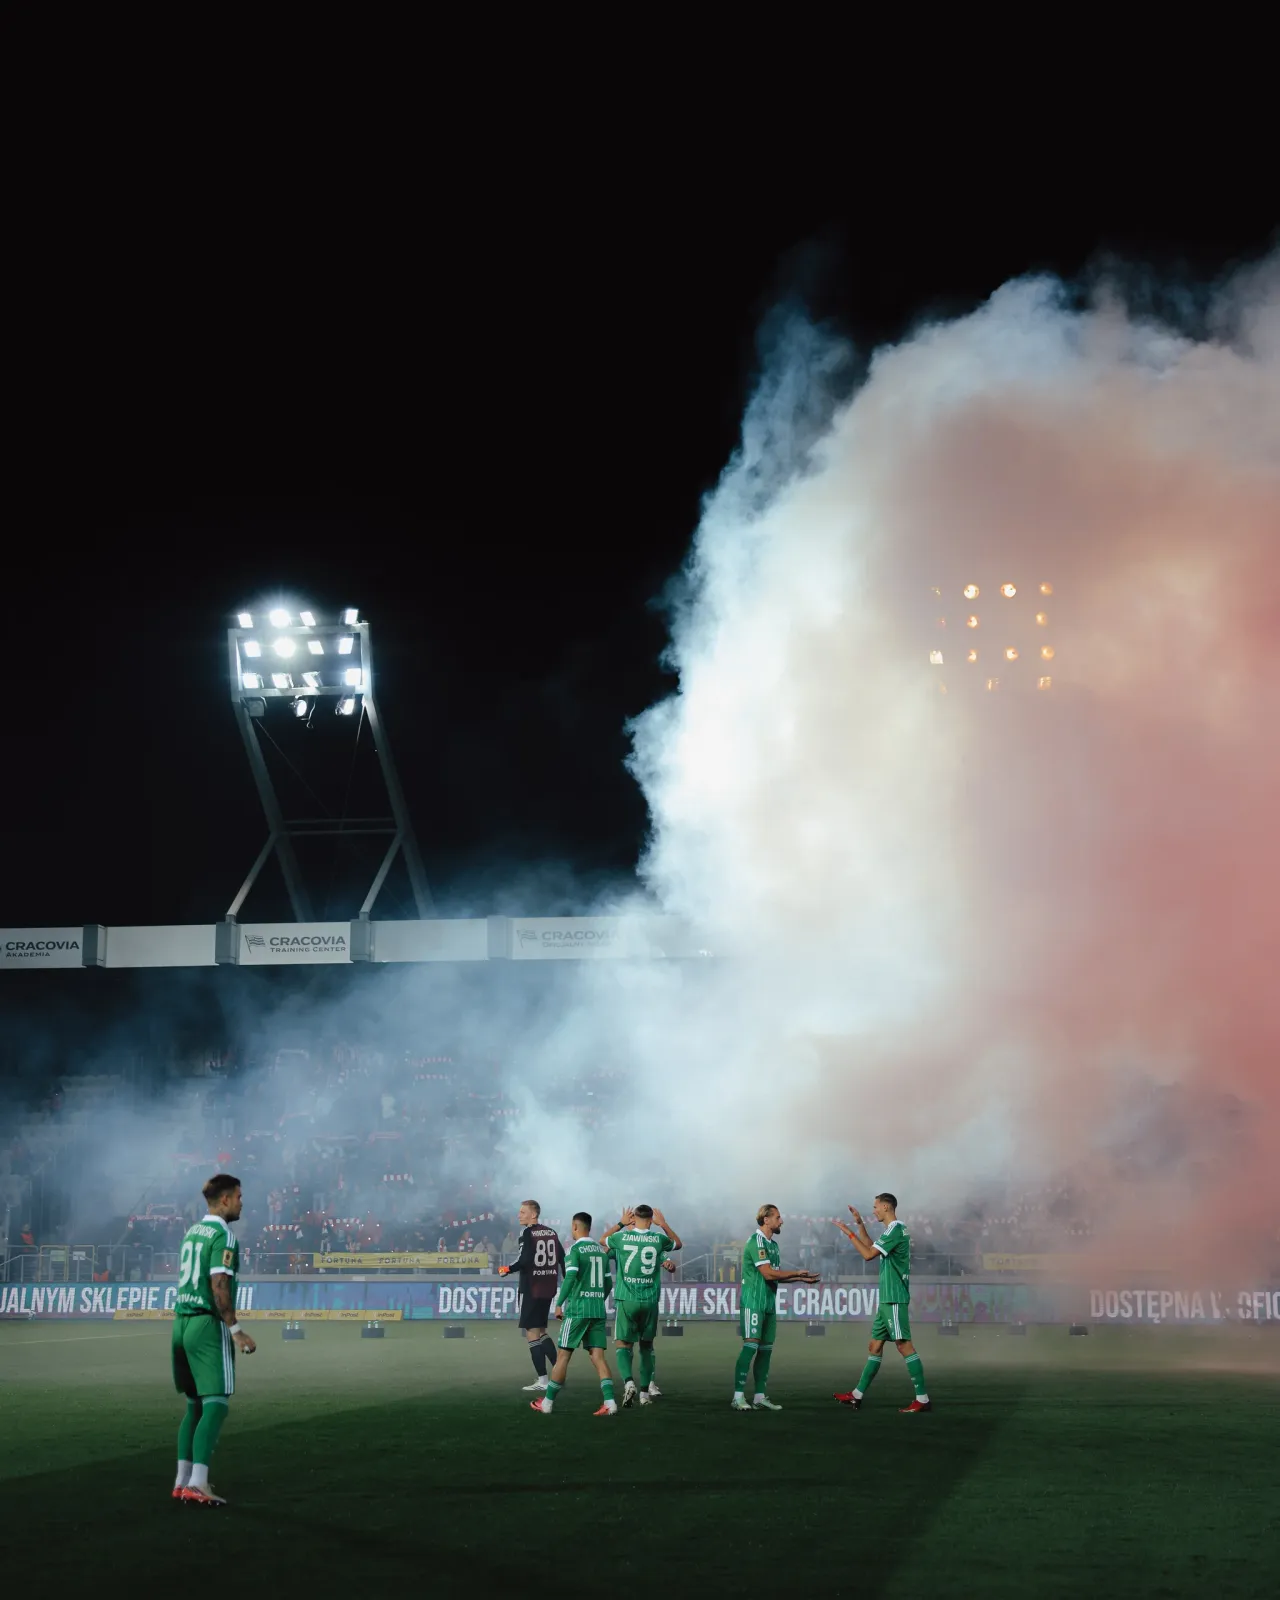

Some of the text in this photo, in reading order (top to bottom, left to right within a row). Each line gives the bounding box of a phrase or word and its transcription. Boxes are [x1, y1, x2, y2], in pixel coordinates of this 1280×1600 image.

[5, 941, 80, 951] CRACOVIA
[269, 935, 346, 946] CRACOVIA
[622, 1233, 660, 1243] ZJAWIŃSKI
[179, 1241, 203, 1291] 91
[320, 1255, 480, 1265] FORTUNA FORTUNA FORTUNA
[534, 1239, 557, 1267] 89
[623, 1244, 658, 1275] 79
[589, 1256, 604, 1288] 11
[623, 1276, 654, 1284] FORTUNA
[79, 1287, 160, 1313] SKLEPIE
[703, 1288, 787, 1315] SKLE
[1090, 1290, 1206, 1323] DOSTĘPNA
[751, 1312, 758, 1326] 8
